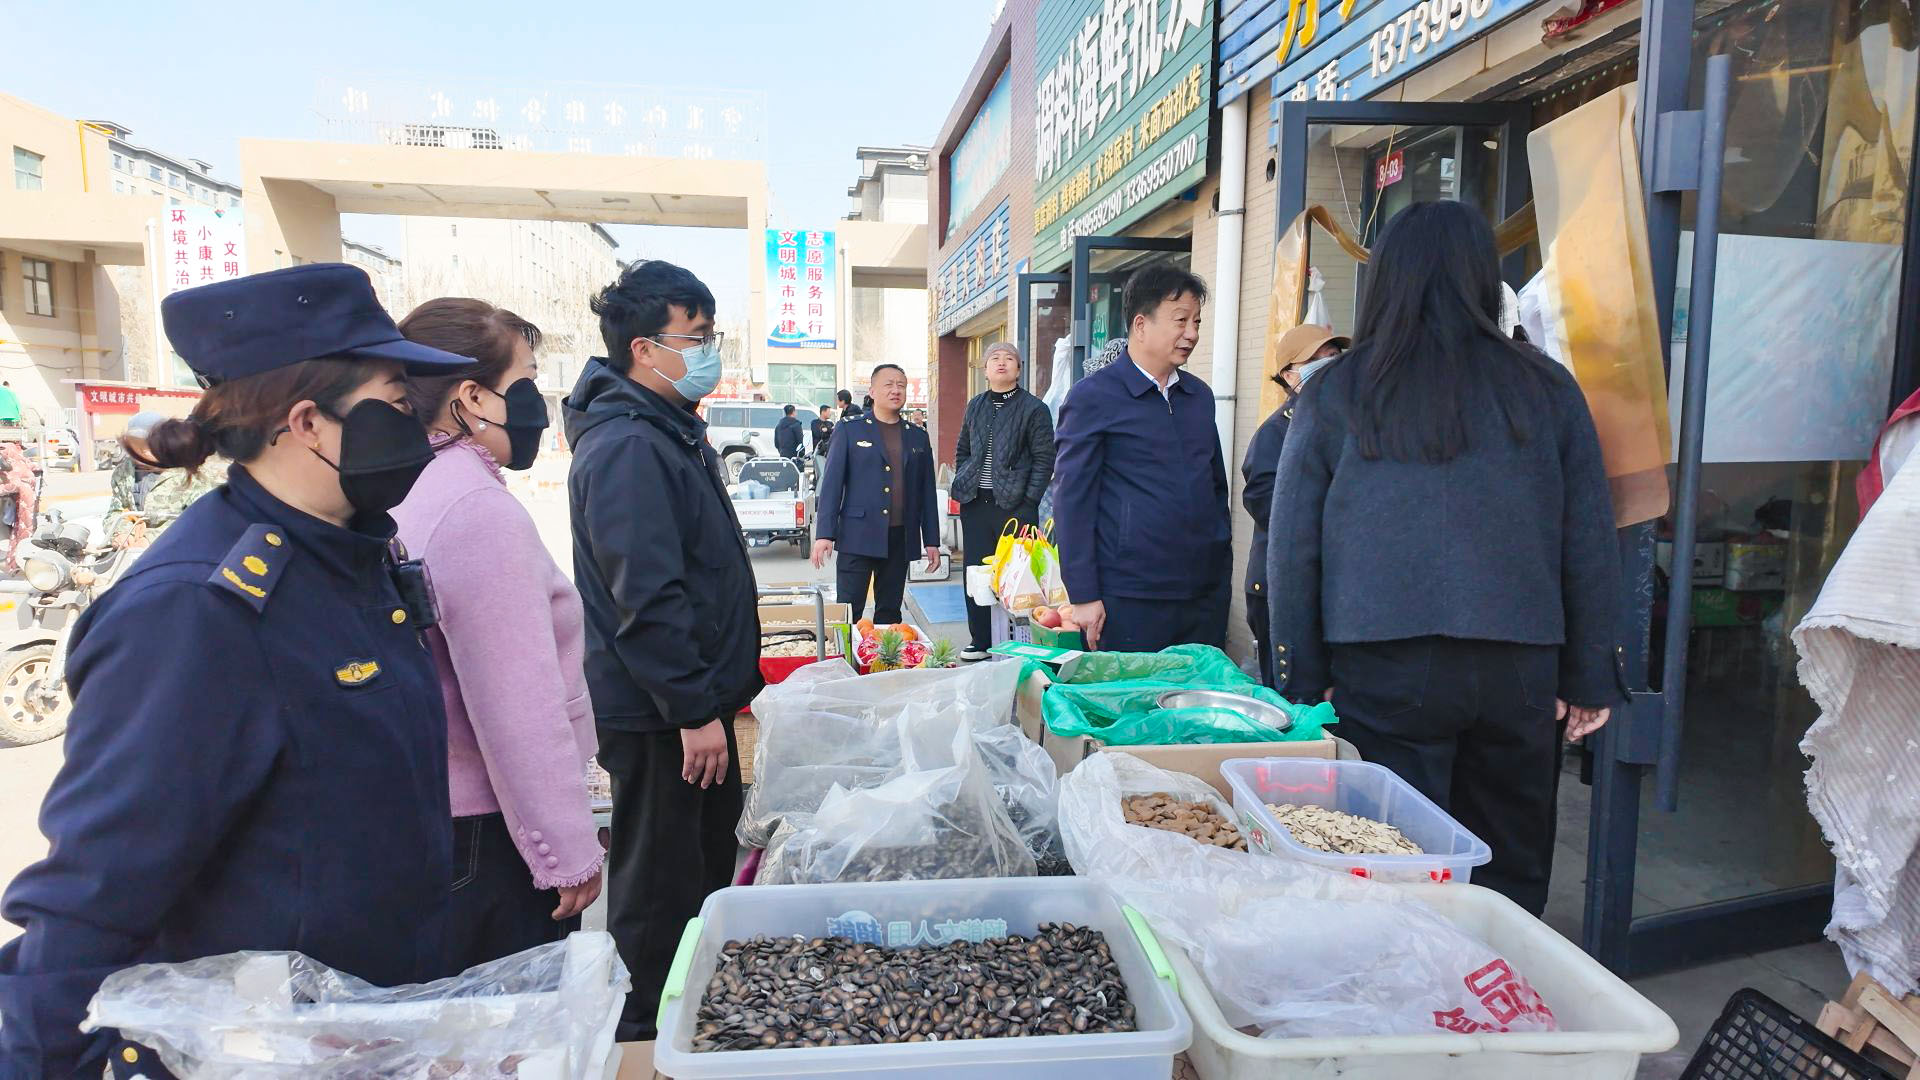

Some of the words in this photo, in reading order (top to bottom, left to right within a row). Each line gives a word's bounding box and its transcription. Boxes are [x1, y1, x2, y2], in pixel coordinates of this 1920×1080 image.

[1140, 64, 1202, 150] 米面油批发
[1126, 134, 1198, 208] 13369550700
[224, 241, 239, 276] 文明
[780, 231, 797, 334] 文明城市共建
[807, 232, 824, 334] 志愿服务同行
